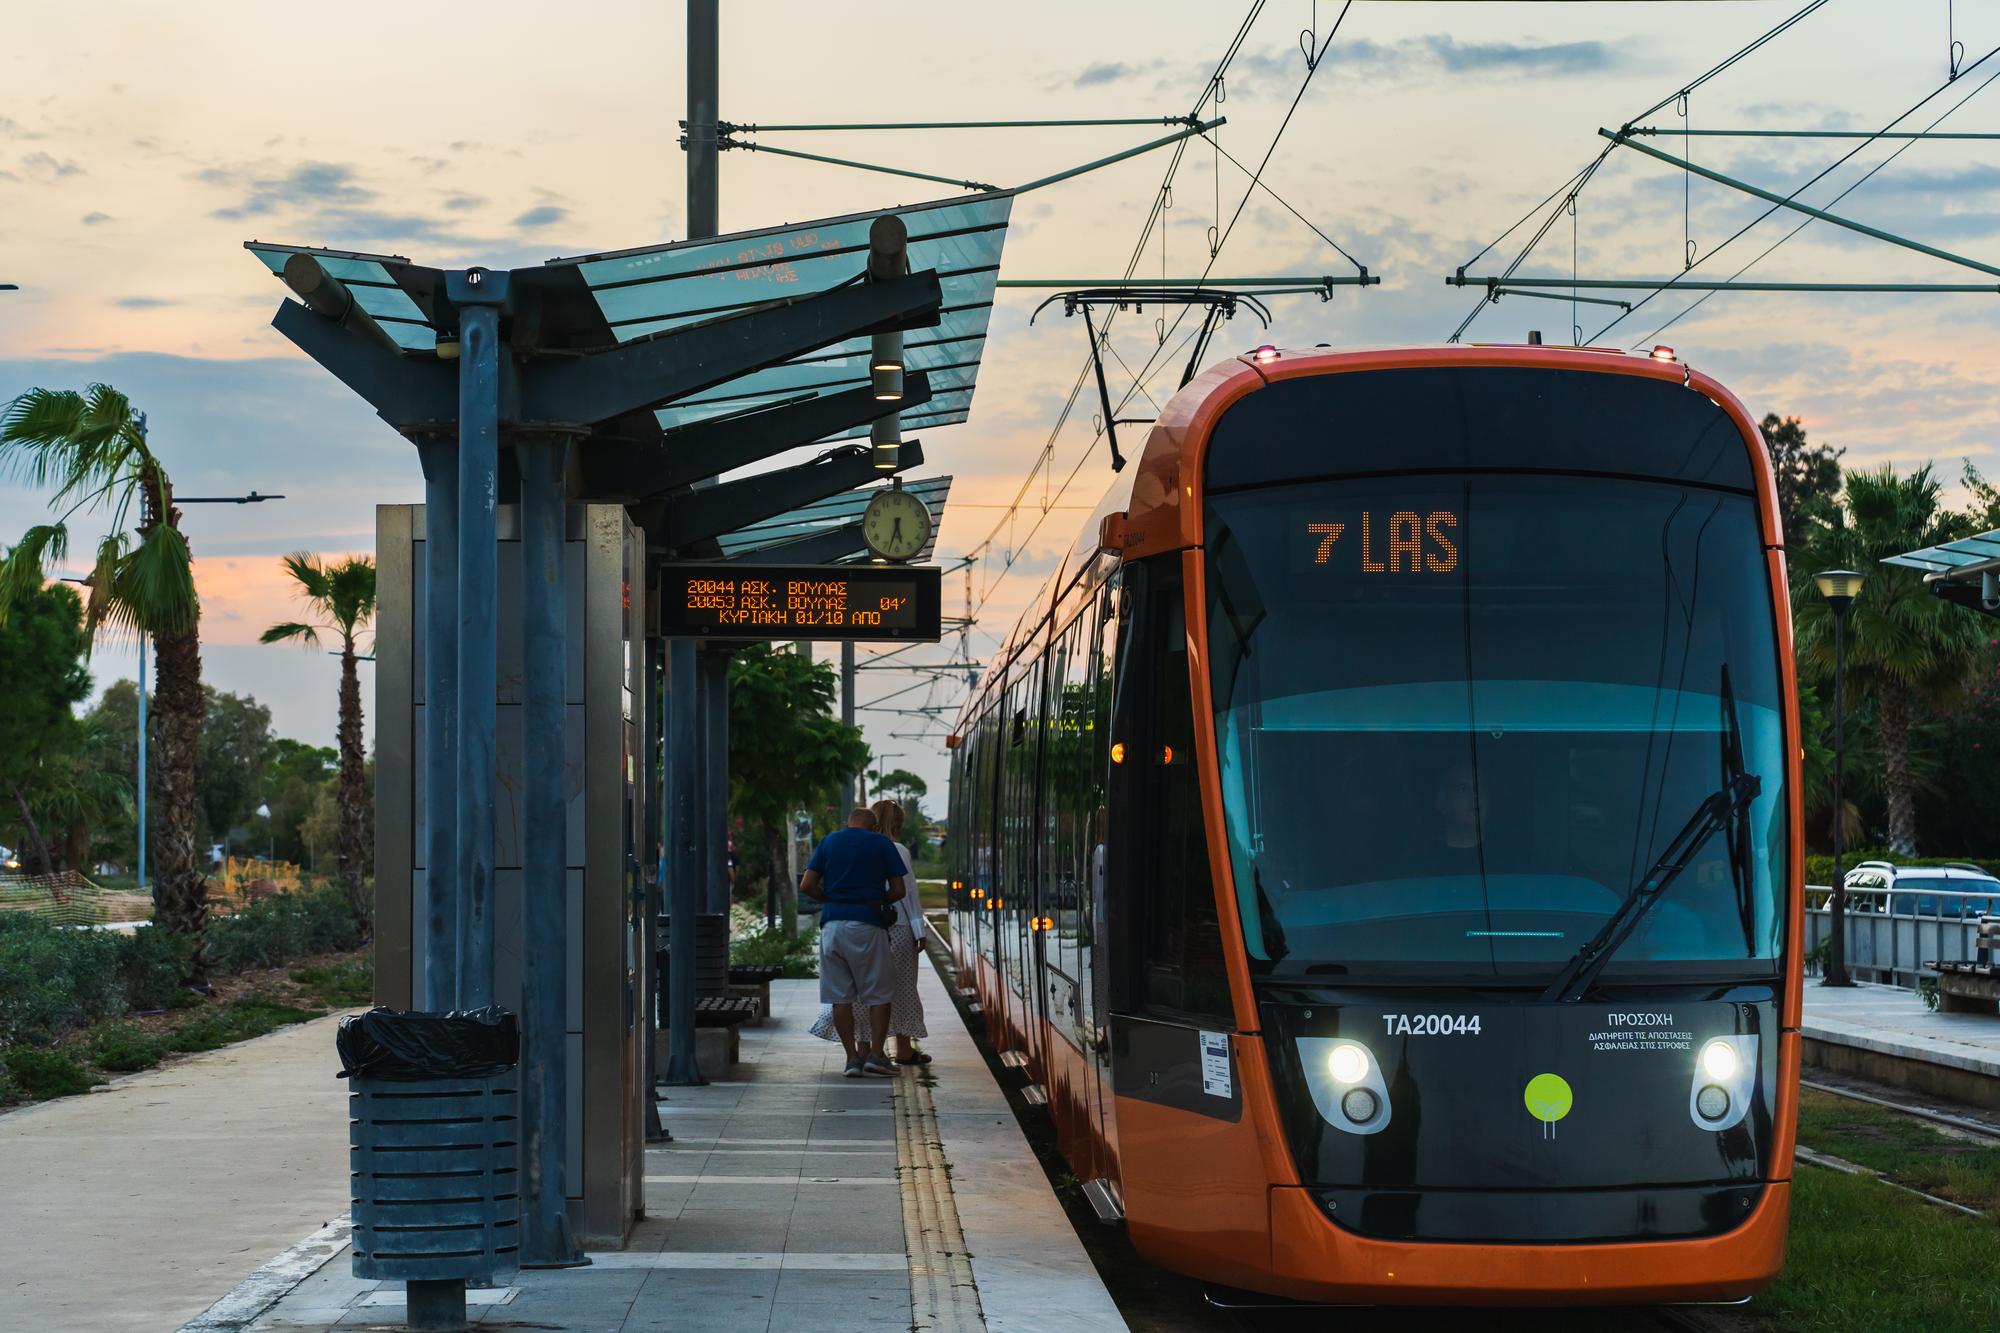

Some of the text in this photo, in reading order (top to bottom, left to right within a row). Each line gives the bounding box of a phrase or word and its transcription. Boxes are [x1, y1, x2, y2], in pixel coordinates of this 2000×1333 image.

[1308, 511, 1457, 572] 7 LAS
[687, 580, 848, 595] 20044 ΑΣΚ. ΒΟΥΛΑΣ
[687, 595, 735, 609] 20053
[741, 595, 777, 609] ΑΣΚ.
[788, 596, 848, 610] ΒΟΥΛΑΣ
[719, 609, 881, 625] ΚΥΡΙΑΚΗ 01/10 ΑΠΟ
[1383, 1014, 1481, 1036] TA20044
[1608, 1013, 1673, 1026] ΠΡΟΣΟΧΗ
[1588, 1031, 1693, 1041] ΔΙΑΤΗΡΕΙΤΕ ΤΙΣ ΑΠΟΣΤΑΣΕΙΣ
[1593, 1041, 1691, 1051] ΑΣΦΑΛΕΙΑΣ ΣΤΙΣ ΣΤΡΟΦΕΣ
